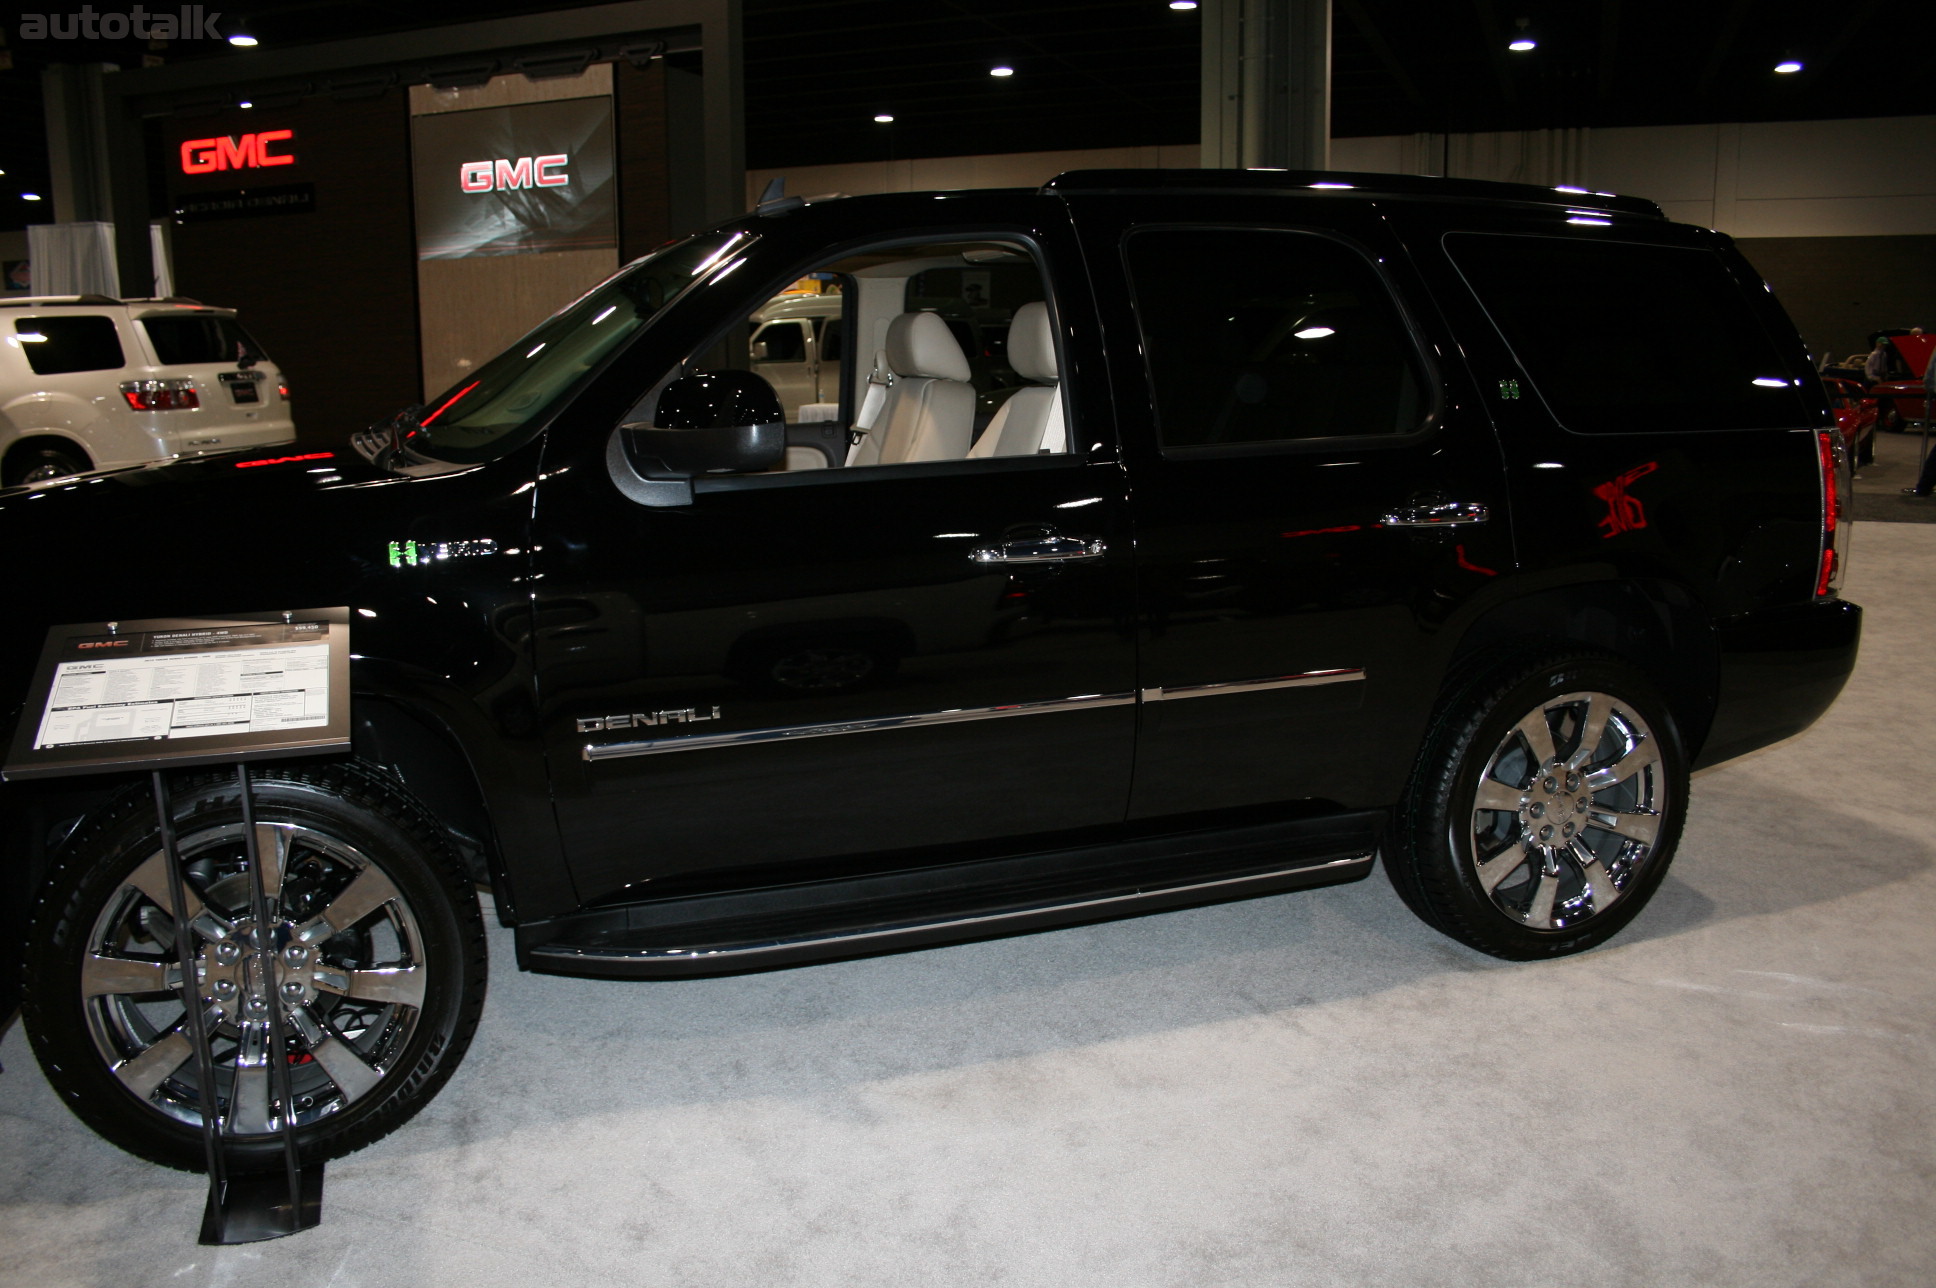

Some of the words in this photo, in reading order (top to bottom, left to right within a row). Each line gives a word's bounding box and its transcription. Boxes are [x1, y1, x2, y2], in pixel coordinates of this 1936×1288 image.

[181, 129, 295, 174] GMC
[460, 154, 568, 194] GMC
[77, 640, 129, 649] GMC
[66, 663, 105, 671] GMC
[576, 705, 721, 733] DENALI
